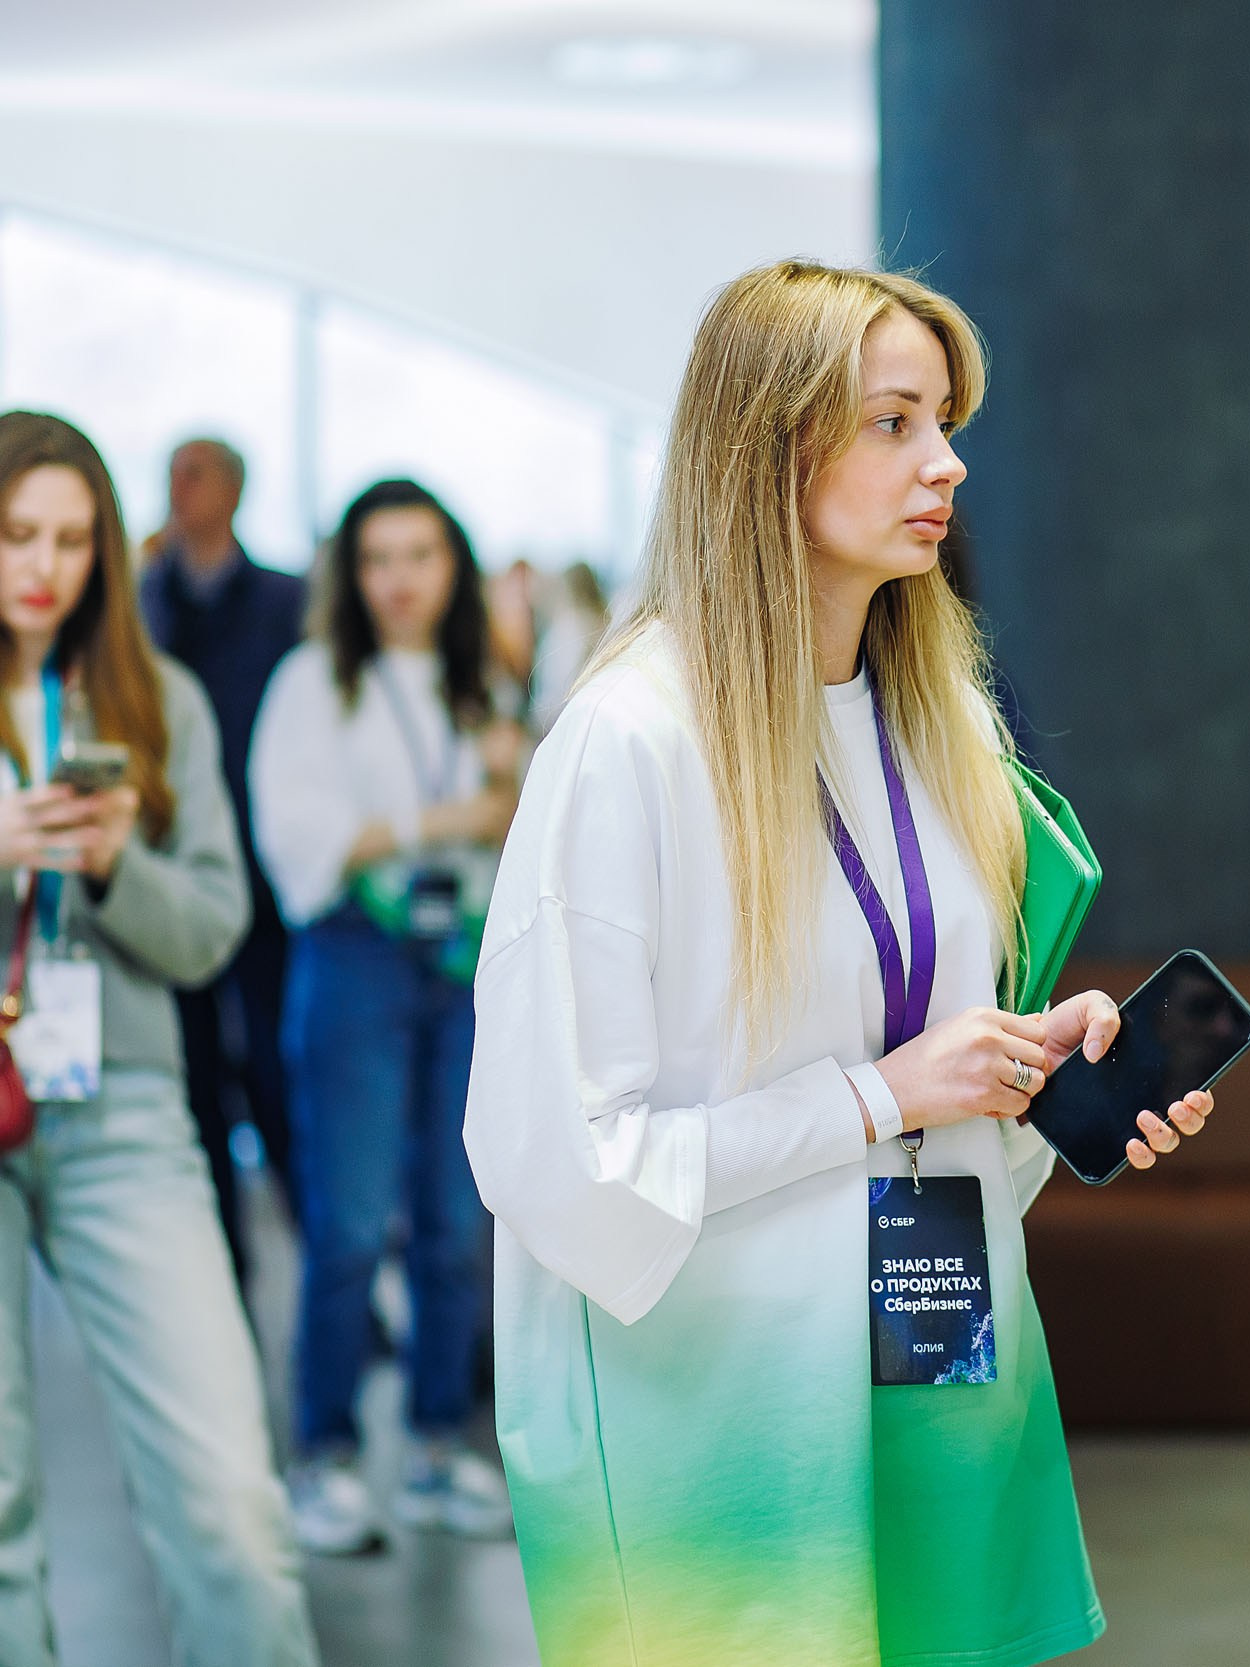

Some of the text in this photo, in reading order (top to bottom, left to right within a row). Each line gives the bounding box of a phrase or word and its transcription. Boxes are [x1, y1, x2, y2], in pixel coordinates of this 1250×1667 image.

[890, 1217, 916, 1227] СБЕР
[882, 1257, 964, 1273] ЗНАЮ ВСЕ
[870, 1276, 982, 1293] О ПРОДУКТАХ
[884, 1297, 972, 1314] СберБизнес
[913, 1343, 944, 1353] ЮЛИЯ
